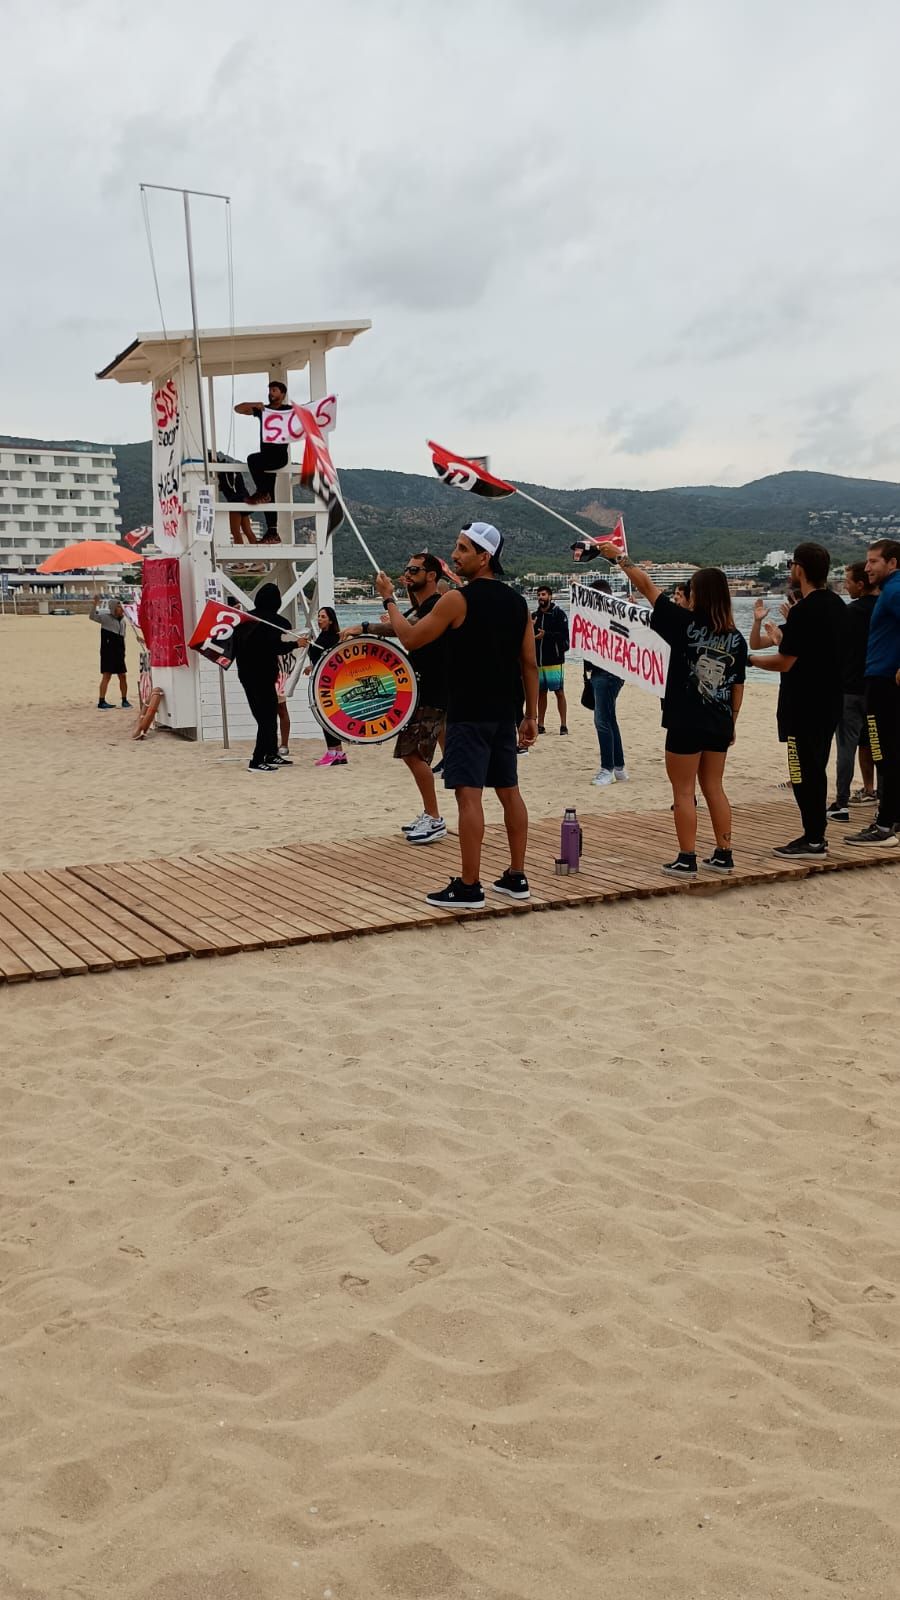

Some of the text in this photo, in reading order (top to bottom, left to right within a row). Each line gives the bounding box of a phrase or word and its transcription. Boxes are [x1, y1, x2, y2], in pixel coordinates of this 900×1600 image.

[200, 610, 241, 654] CGT
[571, 613, 664, 686] PRECARIZACION
[328, 644, 409, 686] SOCORRISTES
[787, 735, 803, 785] LIFEGUARD
[866, 714, 884, 762] LIFEGUARD
